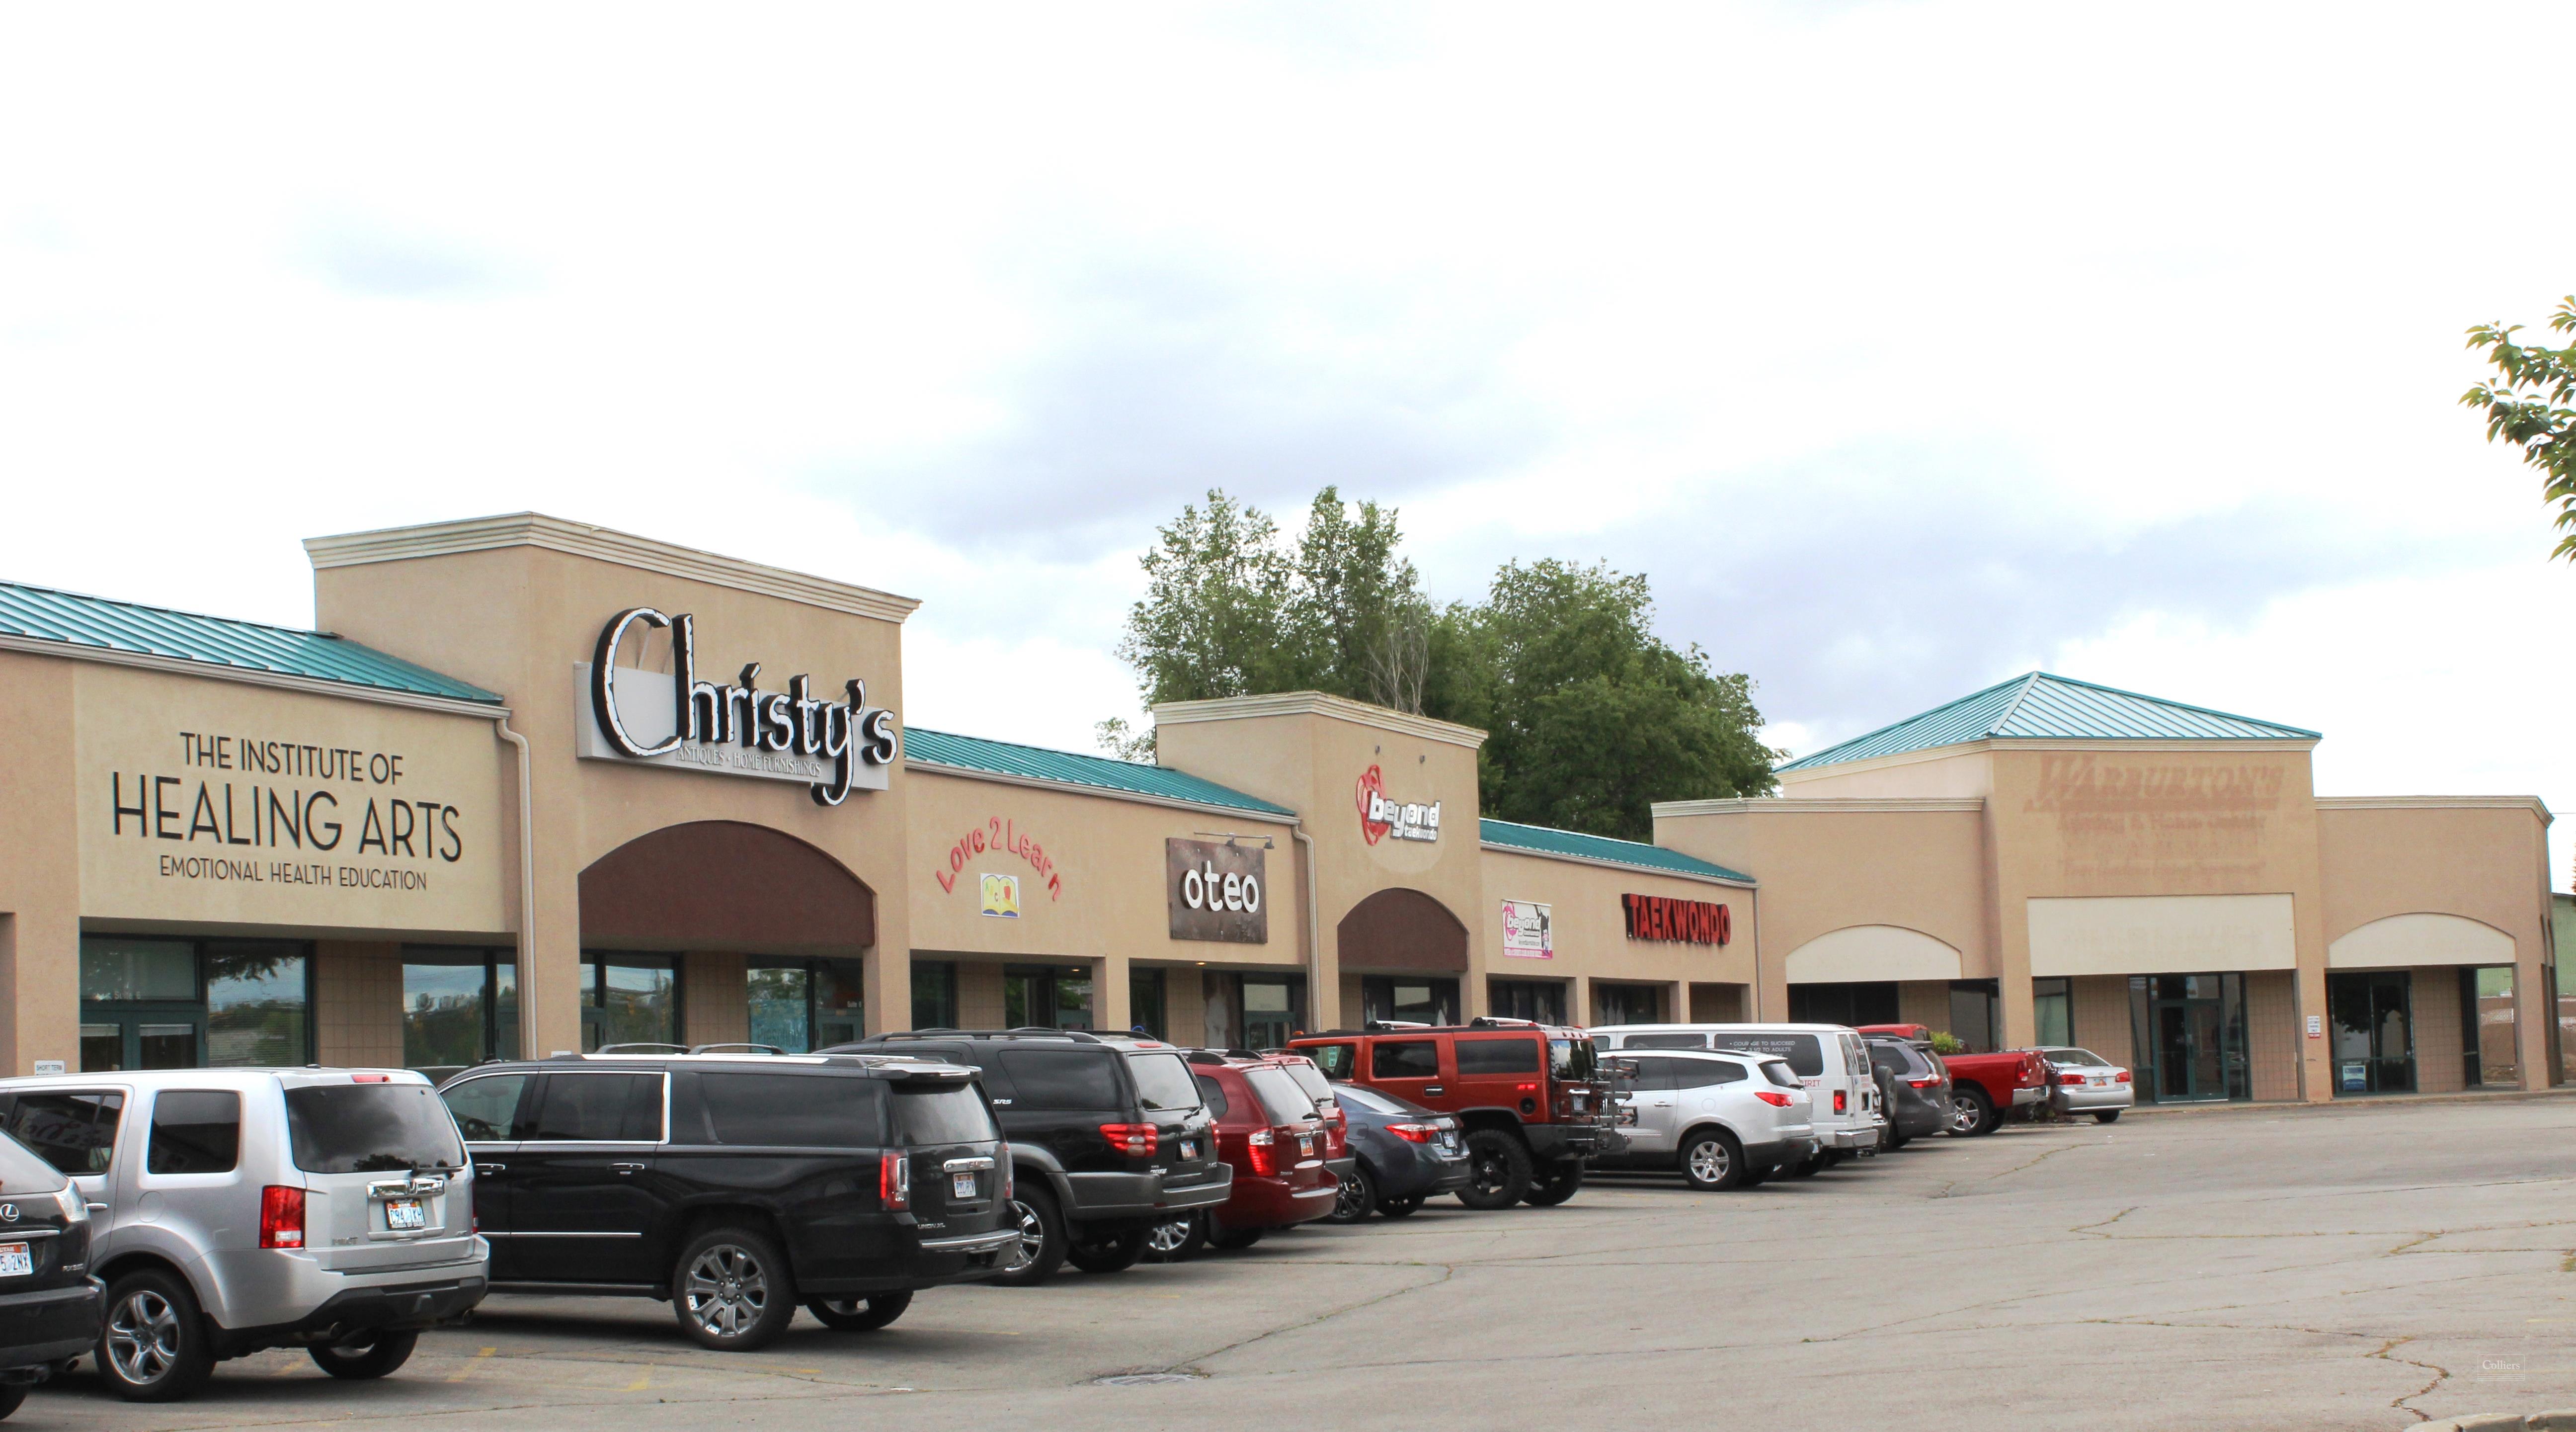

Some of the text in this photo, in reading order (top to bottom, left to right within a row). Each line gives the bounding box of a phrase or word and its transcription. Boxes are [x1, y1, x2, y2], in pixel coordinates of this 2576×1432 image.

[591, 607, 898, 806] Christy's
[180, 732, 403, 785] THE INSTITUTE OF
[677, 746, 822, 777] ANTIQUES HOME FURNISHINGS
[113, 772, 462, 862] HEALING ARTS
[1368, 790, 1441, 837] beyond
[1404, 824, 1438, 841] taekwondo
[161, 855, 426, 890] EMOTIONAL HEALTH EDUCATION
[936, 816, 1062, 902] Love 2 Learn
[1185, 860, 1260, 914] oteo
[1507, 913, 1541, 936] beyond
[1623, 893, 1731, 945] TAEKWONDO
